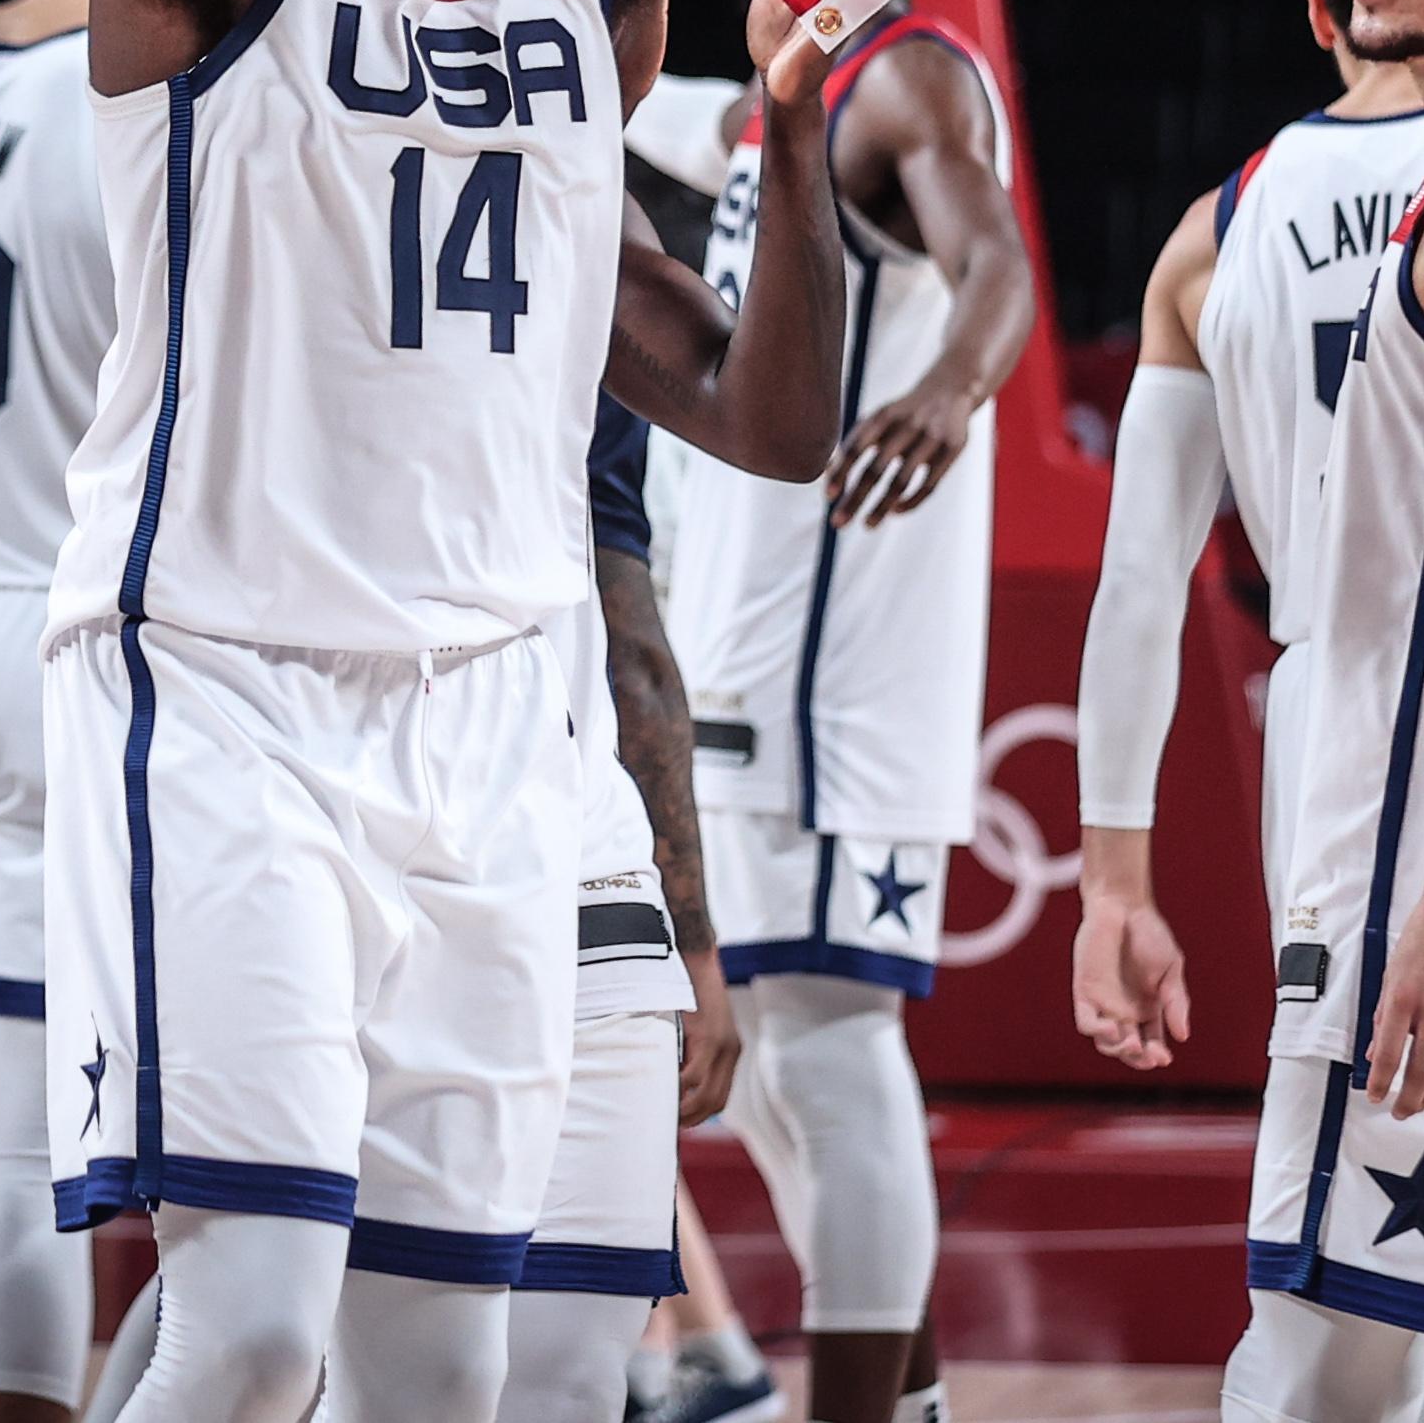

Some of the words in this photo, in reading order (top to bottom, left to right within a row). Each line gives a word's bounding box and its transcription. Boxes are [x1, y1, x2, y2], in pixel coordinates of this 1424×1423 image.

[326, 2, 588, 128] USA
[389, 147, 529, 354] 14
[1287, 190, 1414, 274] LAVI
